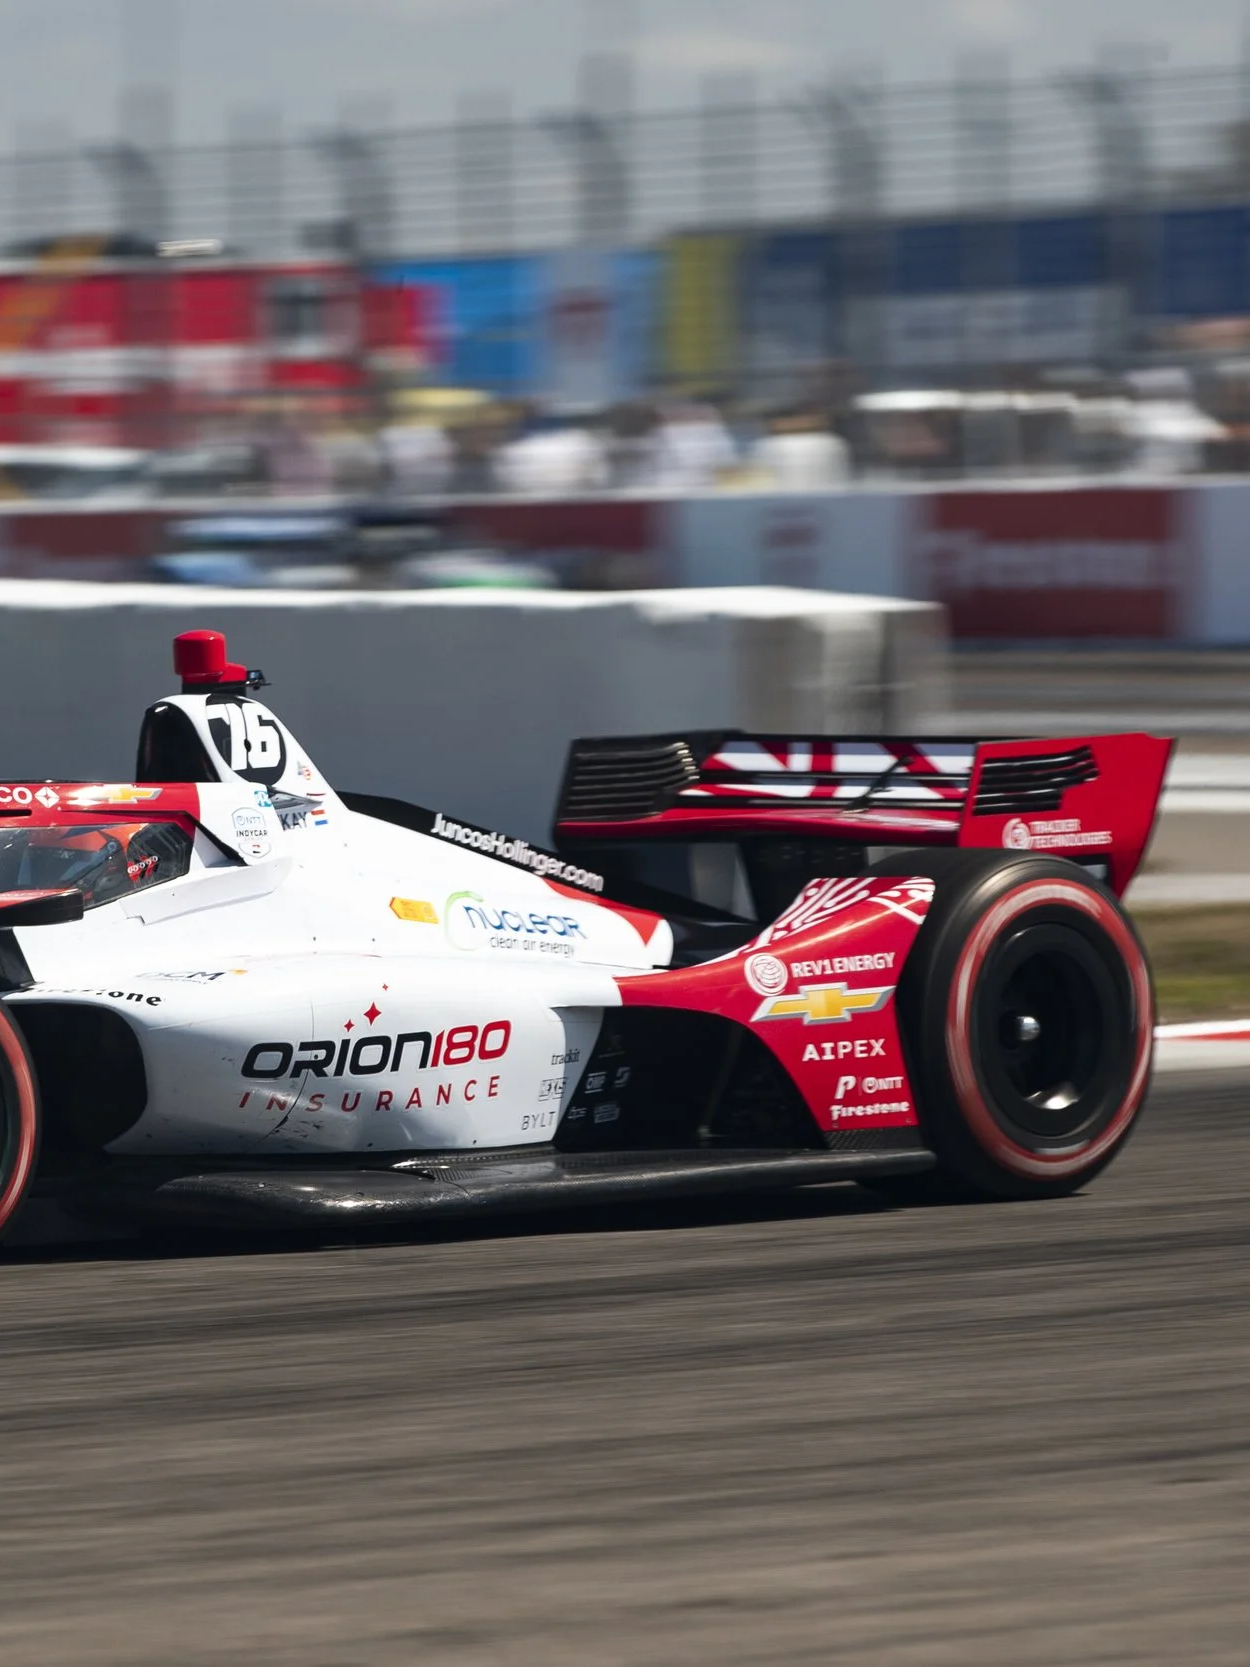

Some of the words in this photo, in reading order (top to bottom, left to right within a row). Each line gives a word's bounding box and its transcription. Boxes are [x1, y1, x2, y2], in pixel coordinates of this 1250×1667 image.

[431, 813, 604, 892] JuncosHollinger.com
[802, 1038, 886, 1062] AIPEX
[238, 1075, 501, 1112] INSURANCE
[521, 1111, 556, 1131] BYLT
[829, 1101, 910, 1121] Firestone
